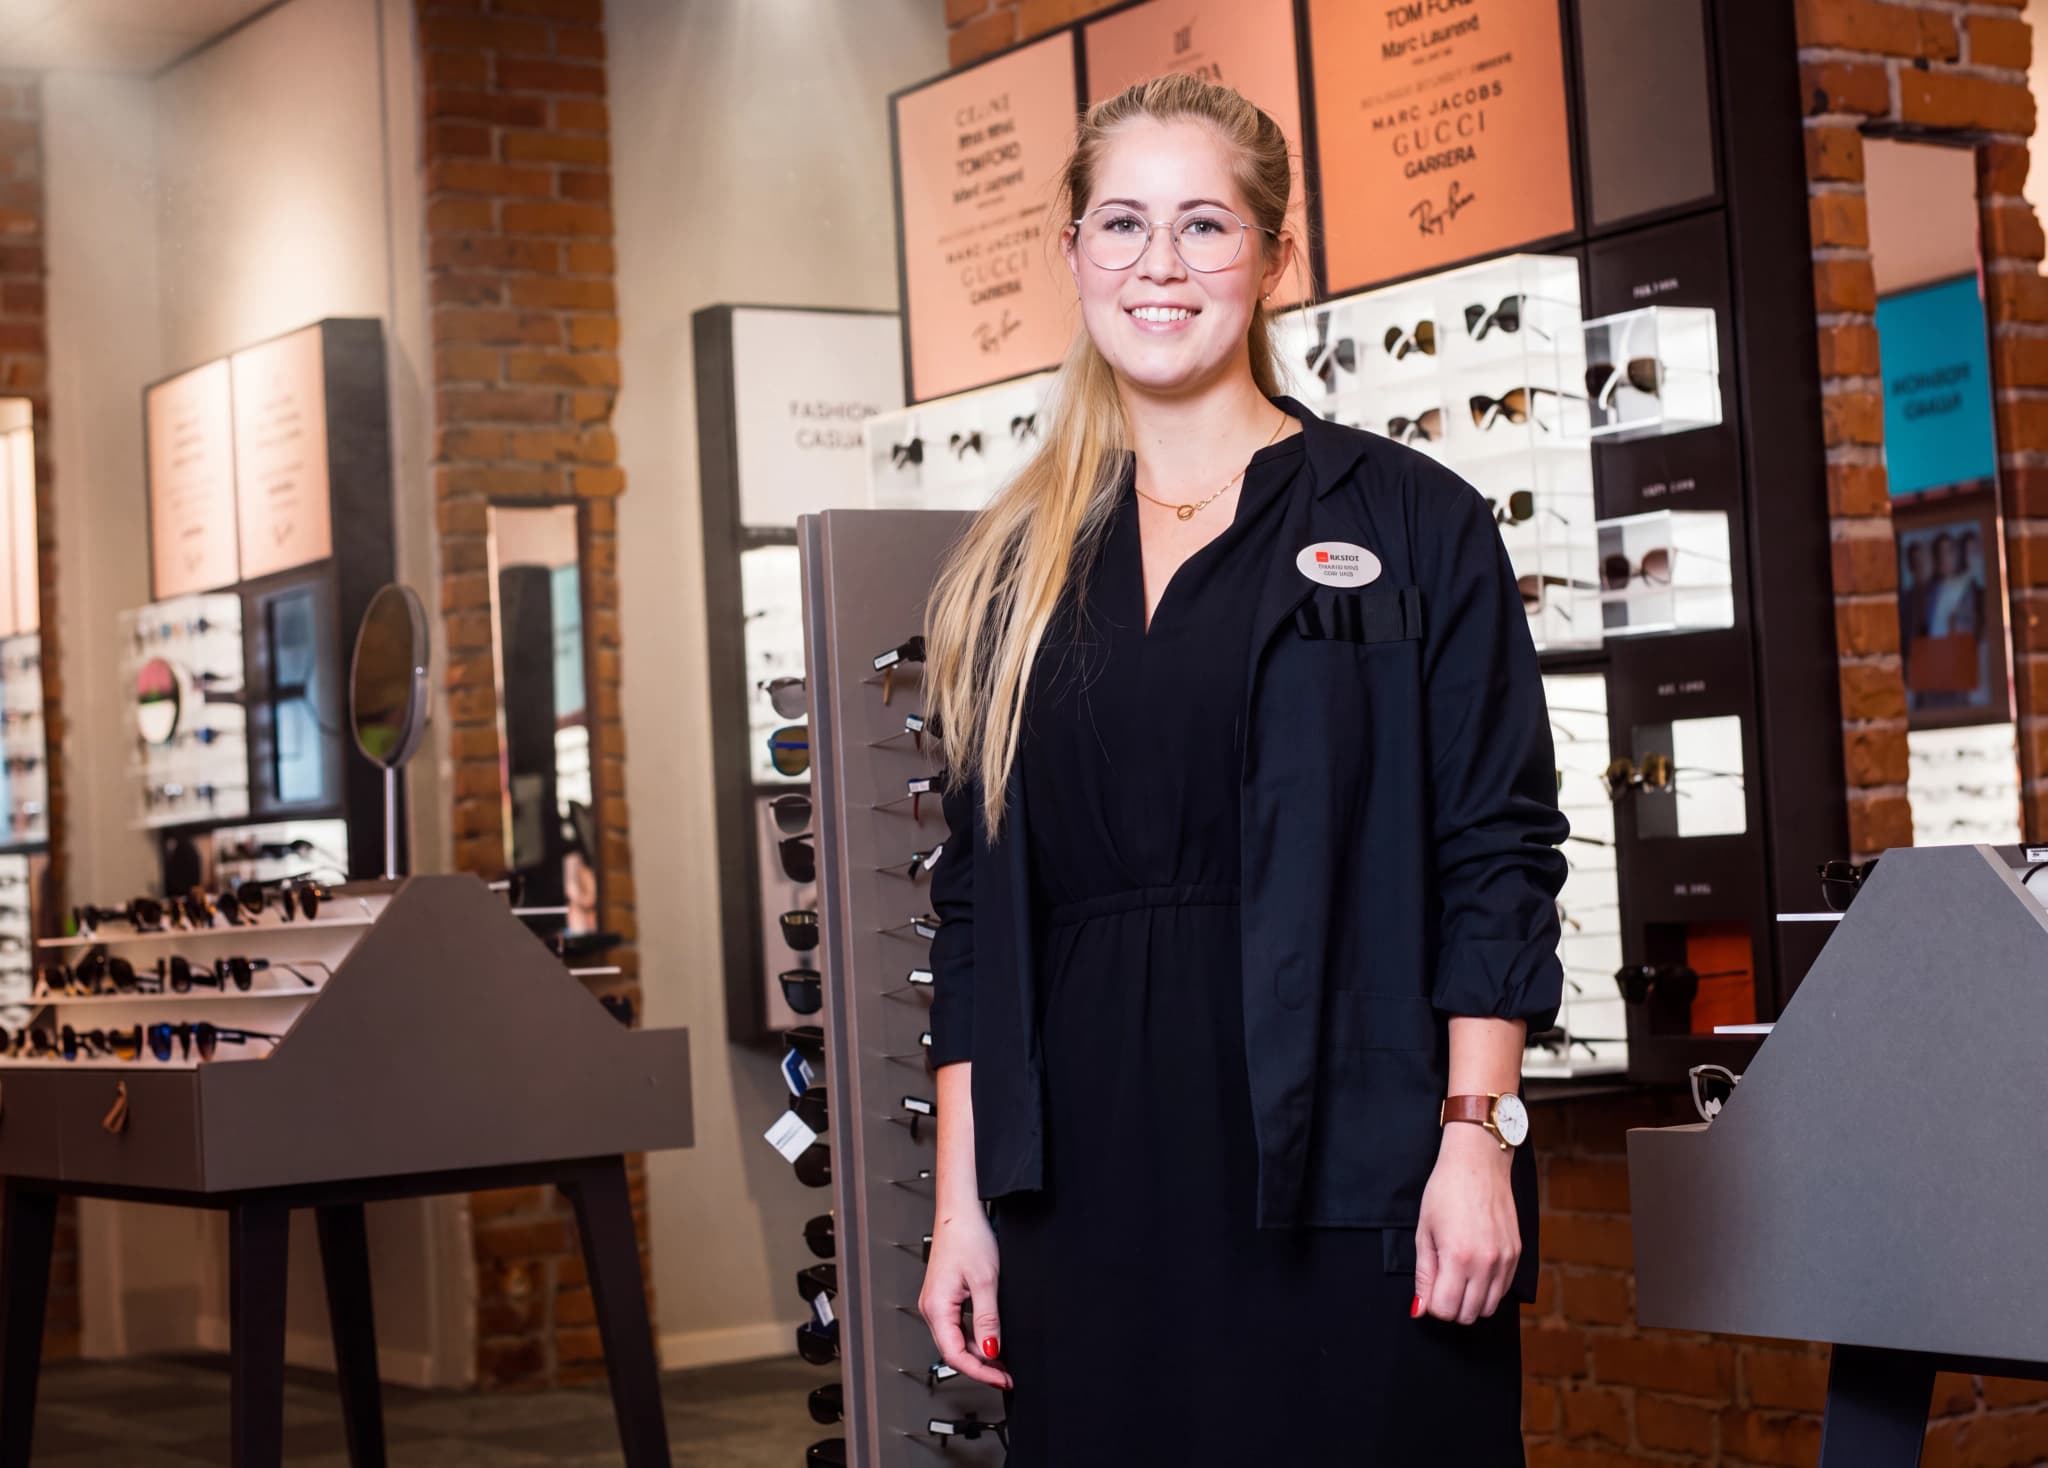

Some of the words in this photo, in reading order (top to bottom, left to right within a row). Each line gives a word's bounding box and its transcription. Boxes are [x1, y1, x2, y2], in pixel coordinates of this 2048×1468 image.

[1386, 1, 1423, 30] TOM
[1427, 0, 1475, 16] FO
[1372, 105, 1420, 130] MARC
[1429, 80, 1503, 117] JACOBS
[1393, 109, 1486, 157] GUCCI
[960, 250, 1029, 288] GUCCI
[795, 429, 864, 449] CASUA
